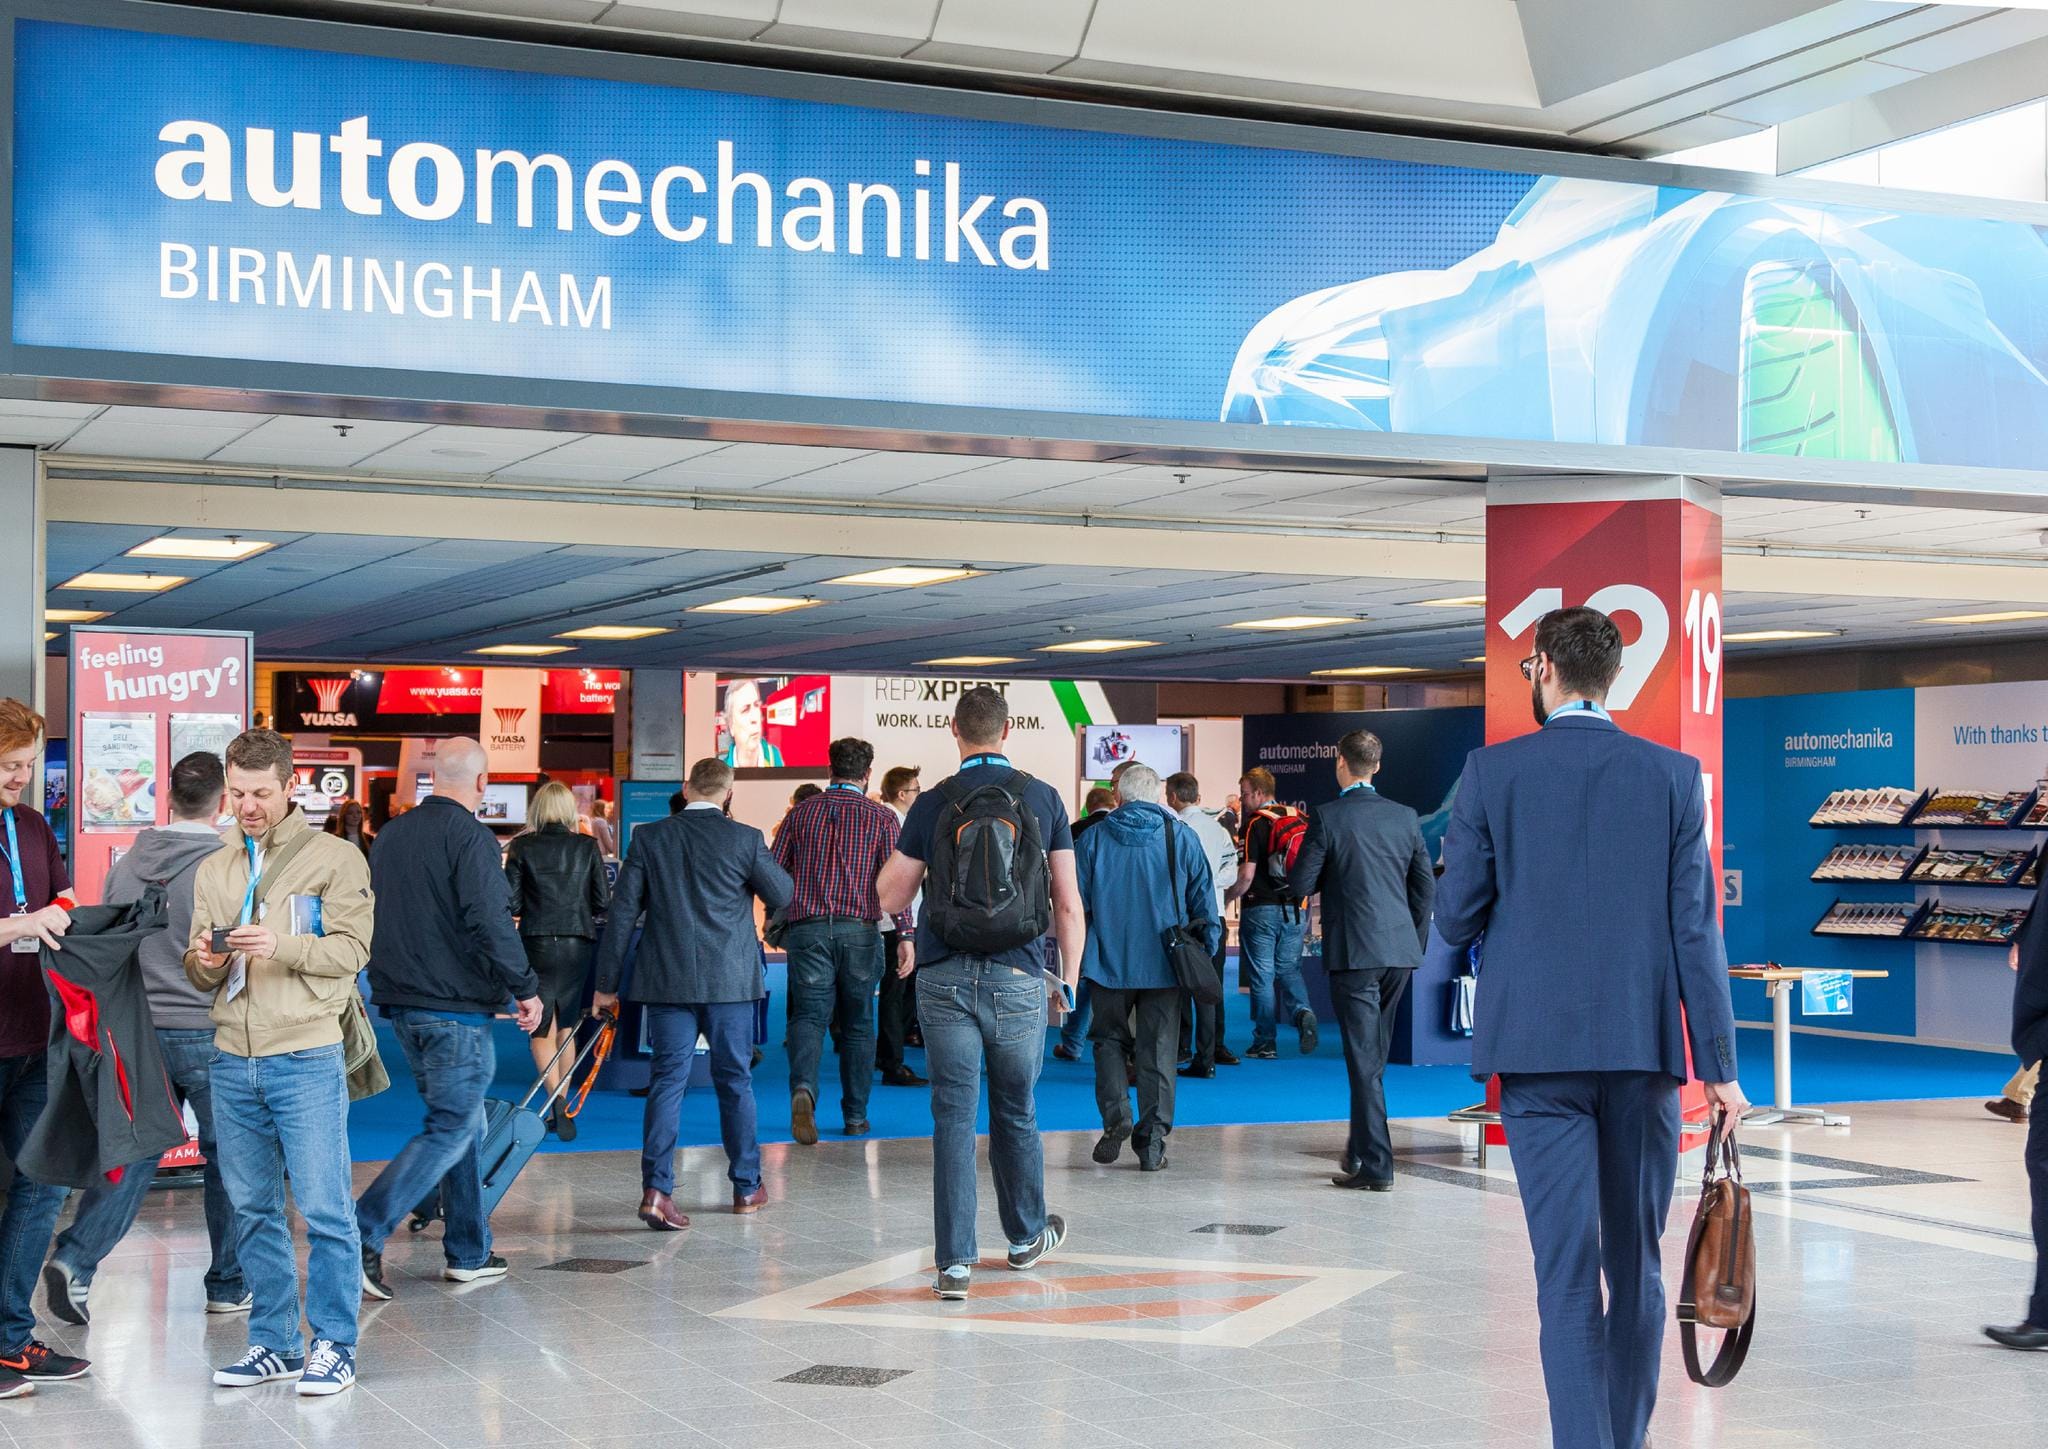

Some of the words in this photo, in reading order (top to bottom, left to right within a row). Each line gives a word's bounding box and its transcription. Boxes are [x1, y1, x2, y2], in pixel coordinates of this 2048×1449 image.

[154, 115, 1051, 272] automechanika
[160, 242, 612, 330] BIRMINGHAM
[80, 643, 165, 670] feeling
[1684, 588, 1721, 716] 19
[104, 656, 241, 702] hungry?
[582, 680, 603, 690] The
[409, 687, 483, 699] www.yuasa.co
[580, 692, 612, 705] battery
[300, 712, 358, 727] YUASA
[876, 713, 923, 728] WORK.
[927, 714, 952, 729] LEA
[490, 735, 526, 744] YUASA
[1784, 727, 1893, 750] automechanika
[1953, 724, 1987, 745] With
[1991, 723, 2038, 745] thanks
[2042, 725, 2048, 743] t
[489, 743, 526, 752] BATTERY
[1259, 741, 1339, 760] automechan
[1784, 756, 1837, 769] BIRMINGHAM
